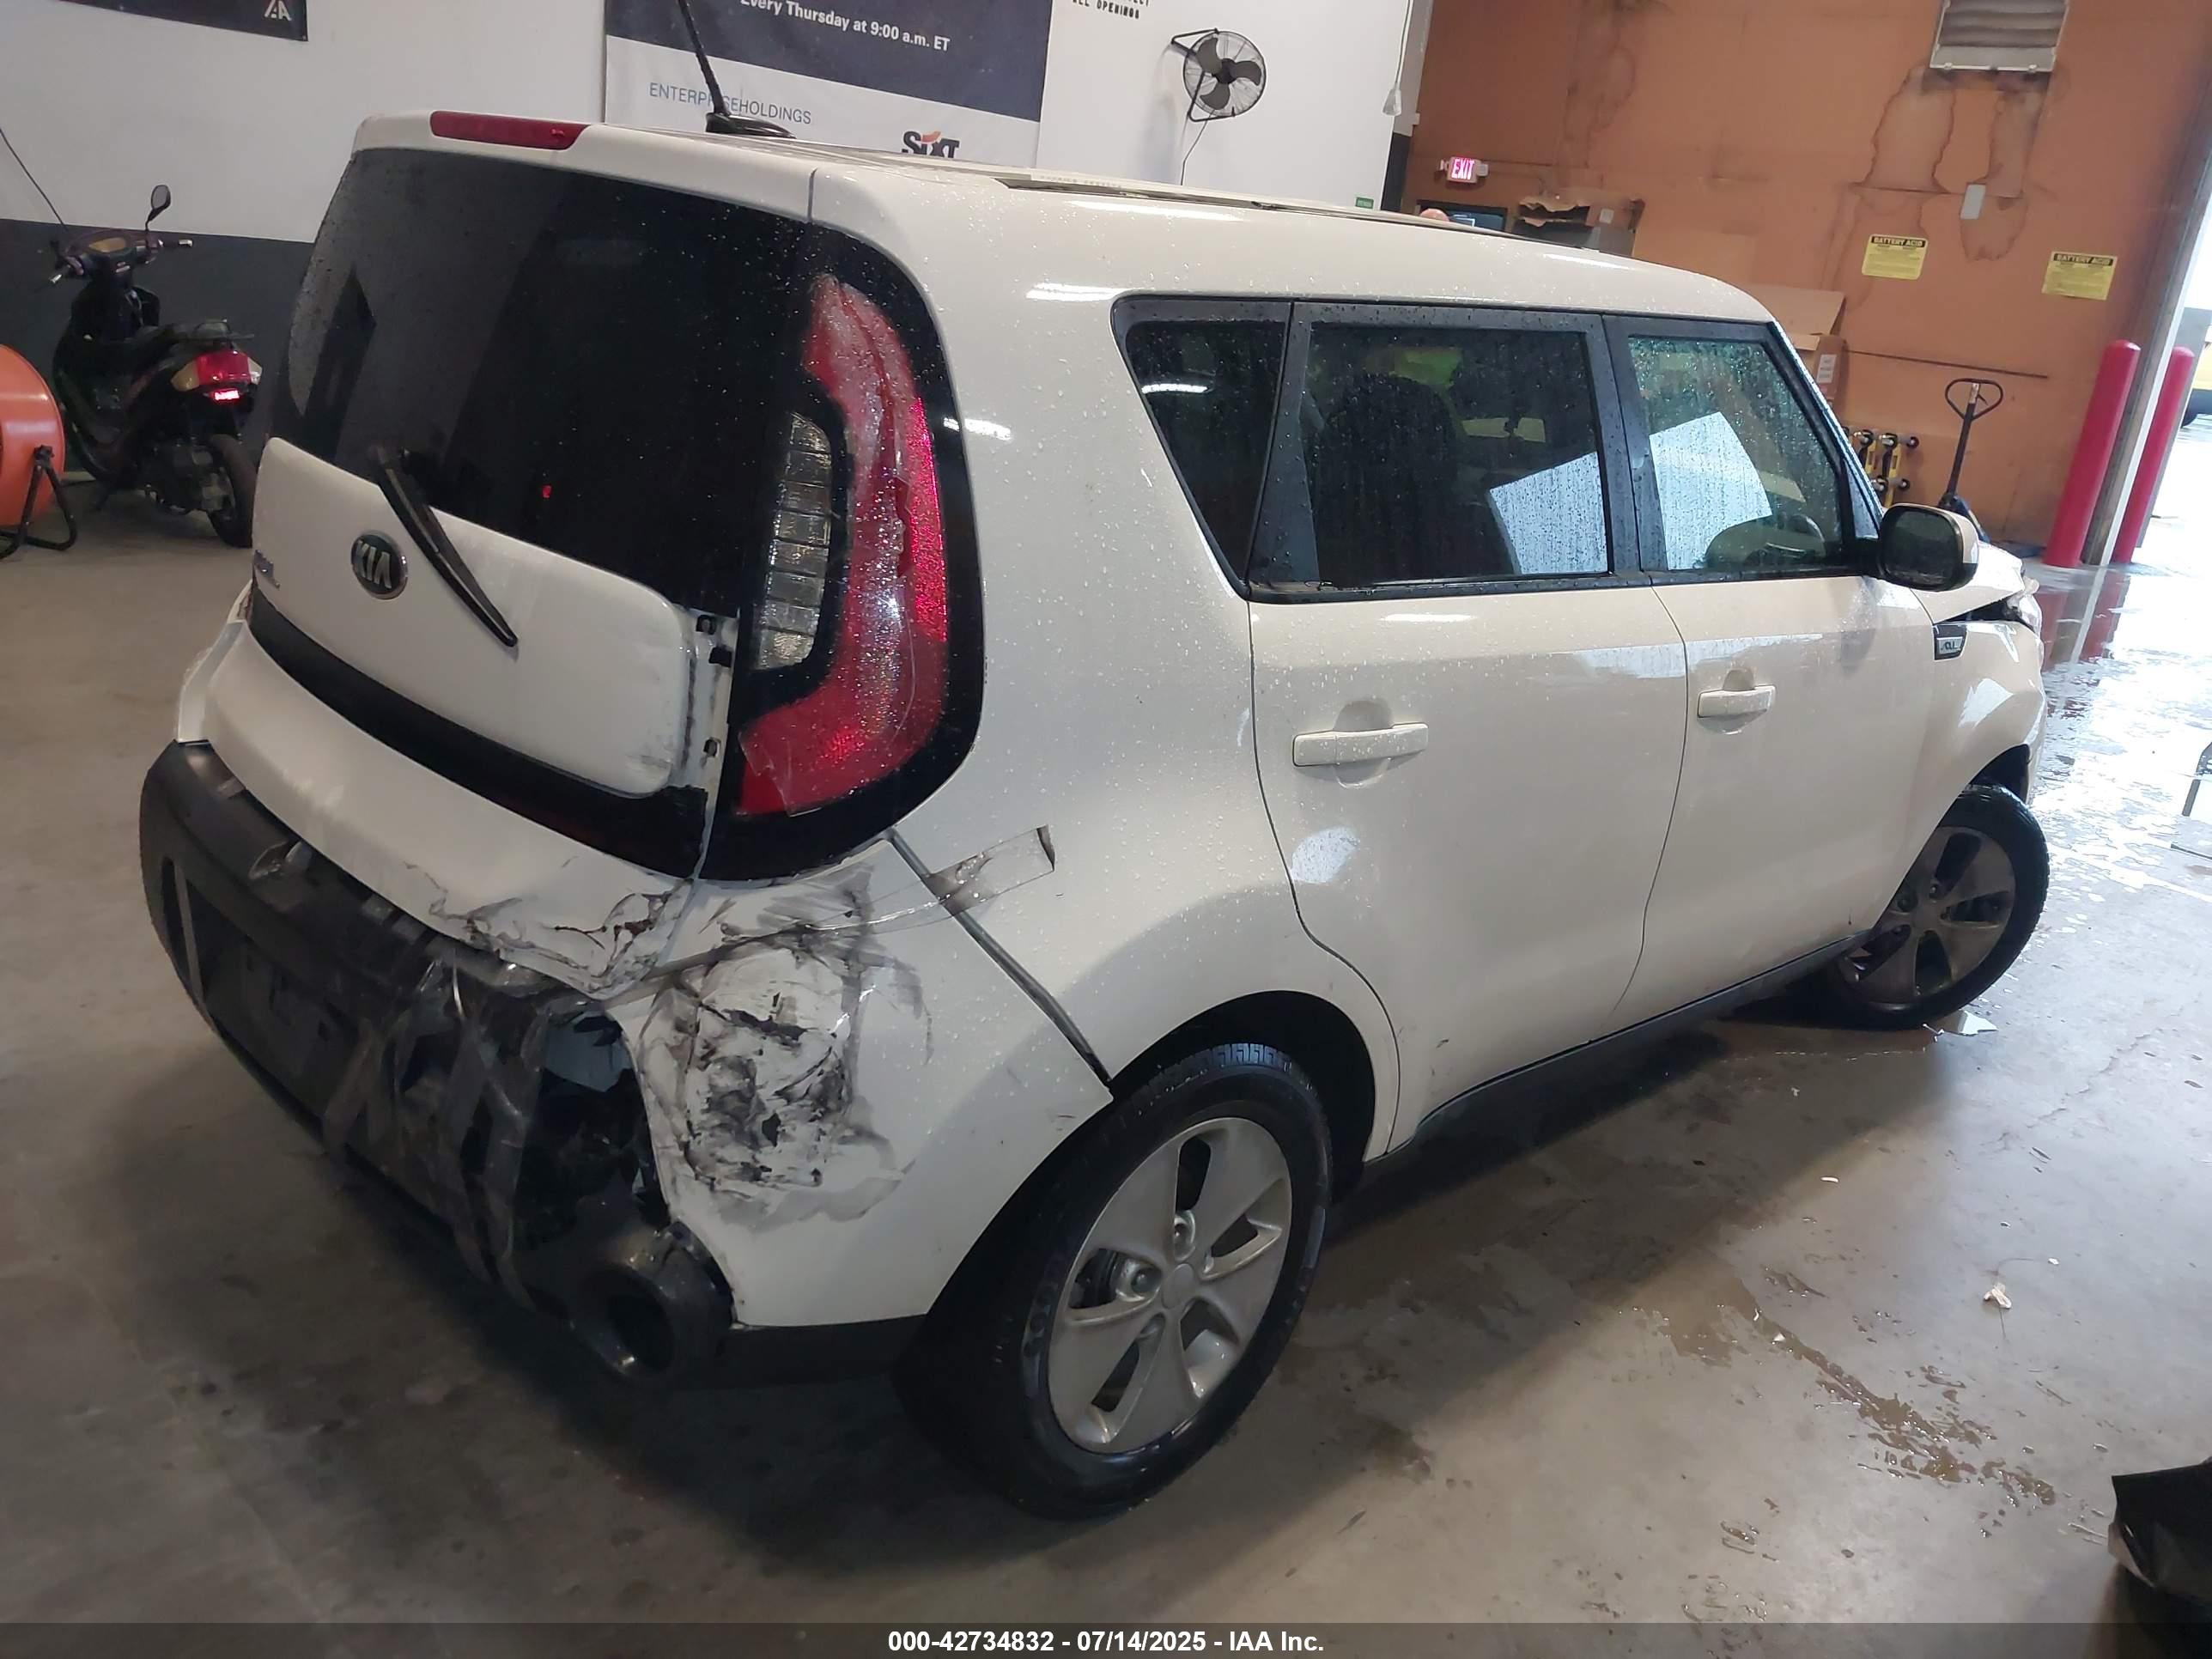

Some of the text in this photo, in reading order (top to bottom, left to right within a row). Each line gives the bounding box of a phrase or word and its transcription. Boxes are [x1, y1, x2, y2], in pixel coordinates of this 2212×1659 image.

[786, 1, 850, 31] Thursday
[853, 19, 867, 33] at
[870, 21, 900, 40] 9:00
[902, 31, 931, 47] a.m.
[933, 35, 951, 52] ET
[1451, 158, 1475, 179] EXIT
[1874, 236, 1905, 246] BATTERY
